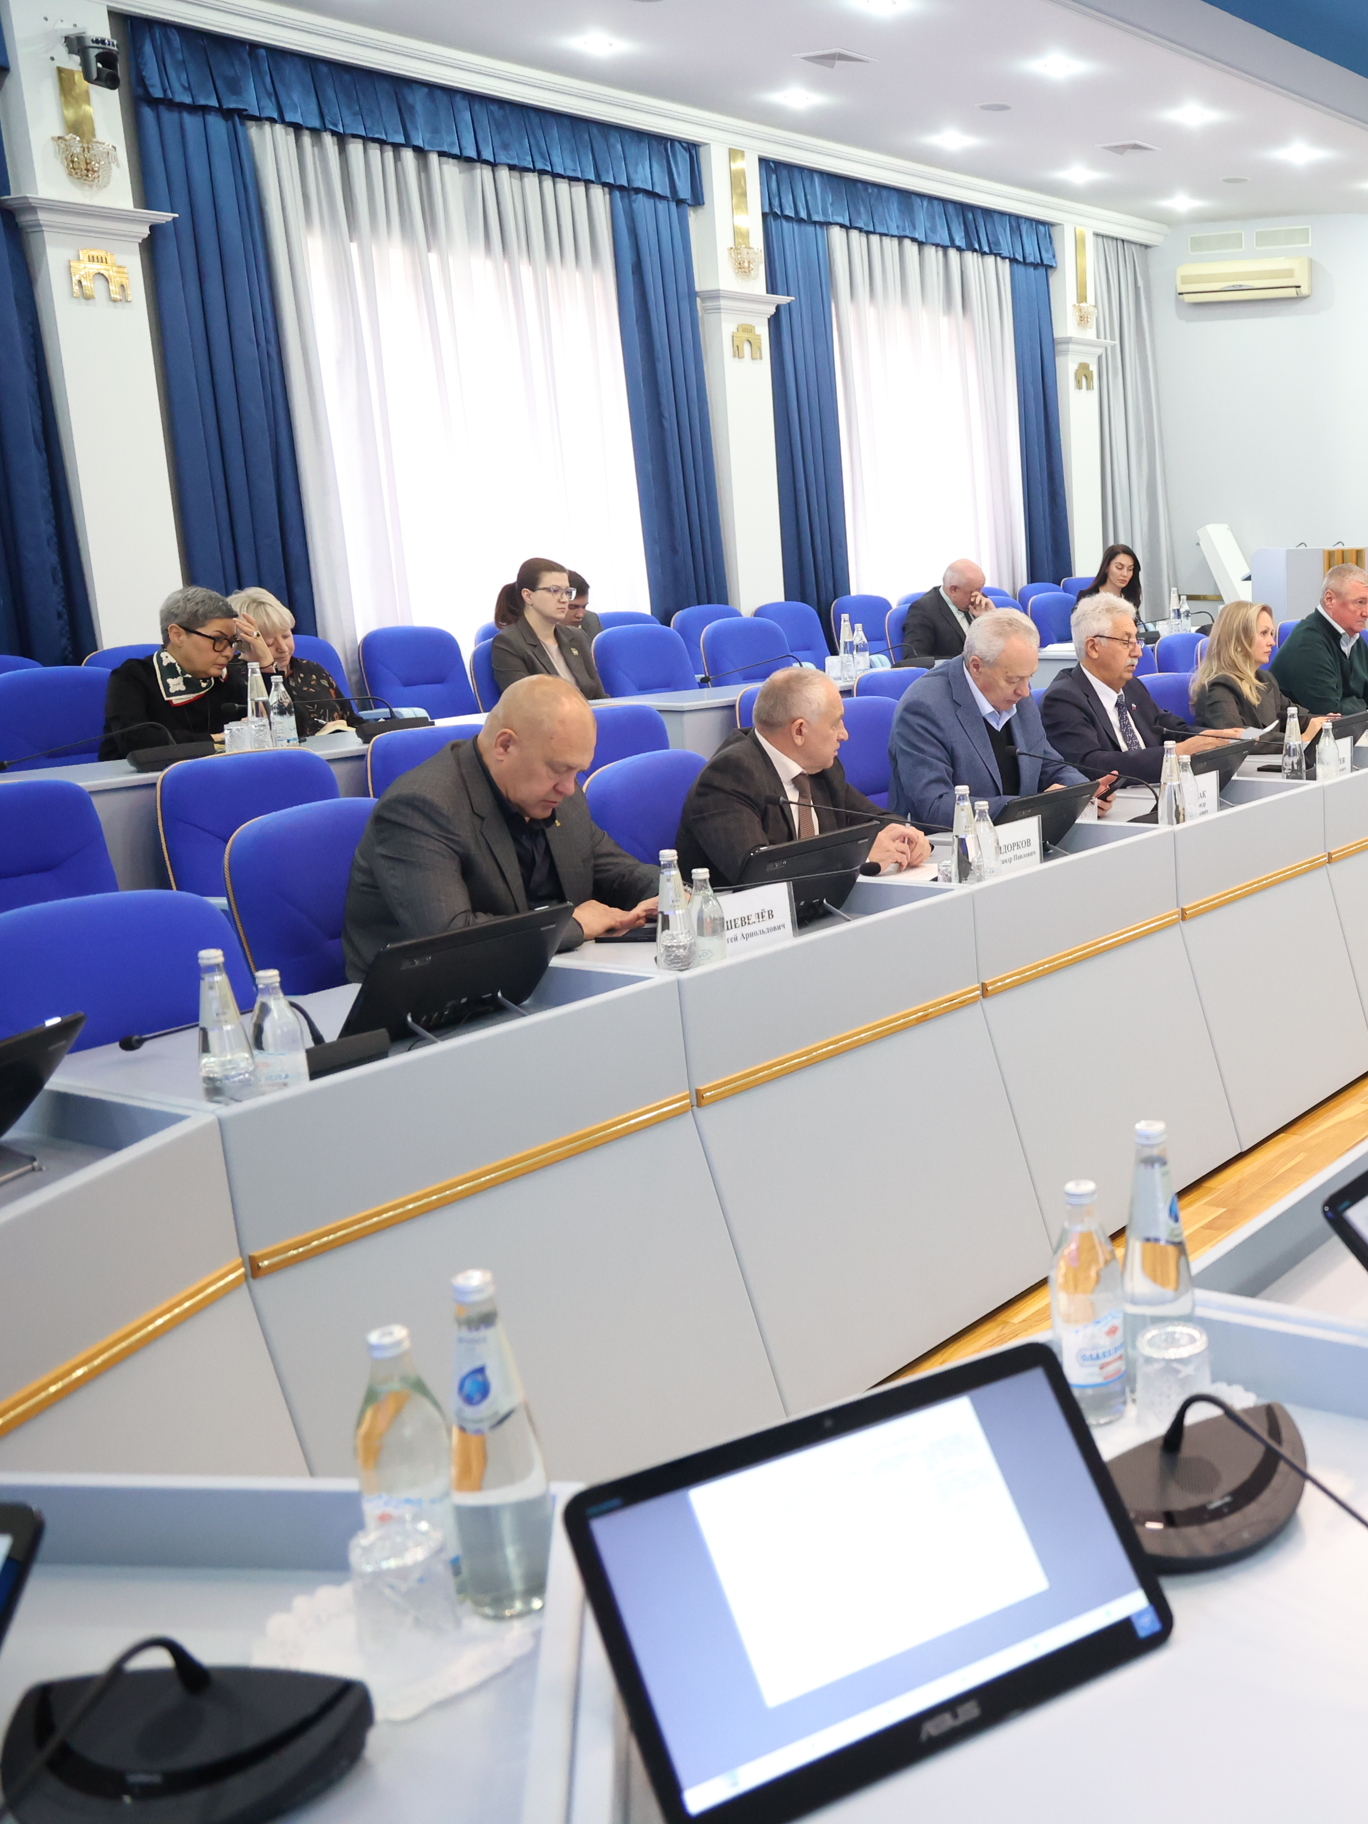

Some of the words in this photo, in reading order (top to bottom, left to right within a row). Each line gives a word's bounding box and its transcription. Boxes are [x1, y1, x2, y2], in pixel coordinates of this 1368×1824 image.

[999, 838, 1032, 855] ДОРКОВ
[1013, 851, 1036, 861] Павлович
[740, 923, 786, 941] Арнольдович
